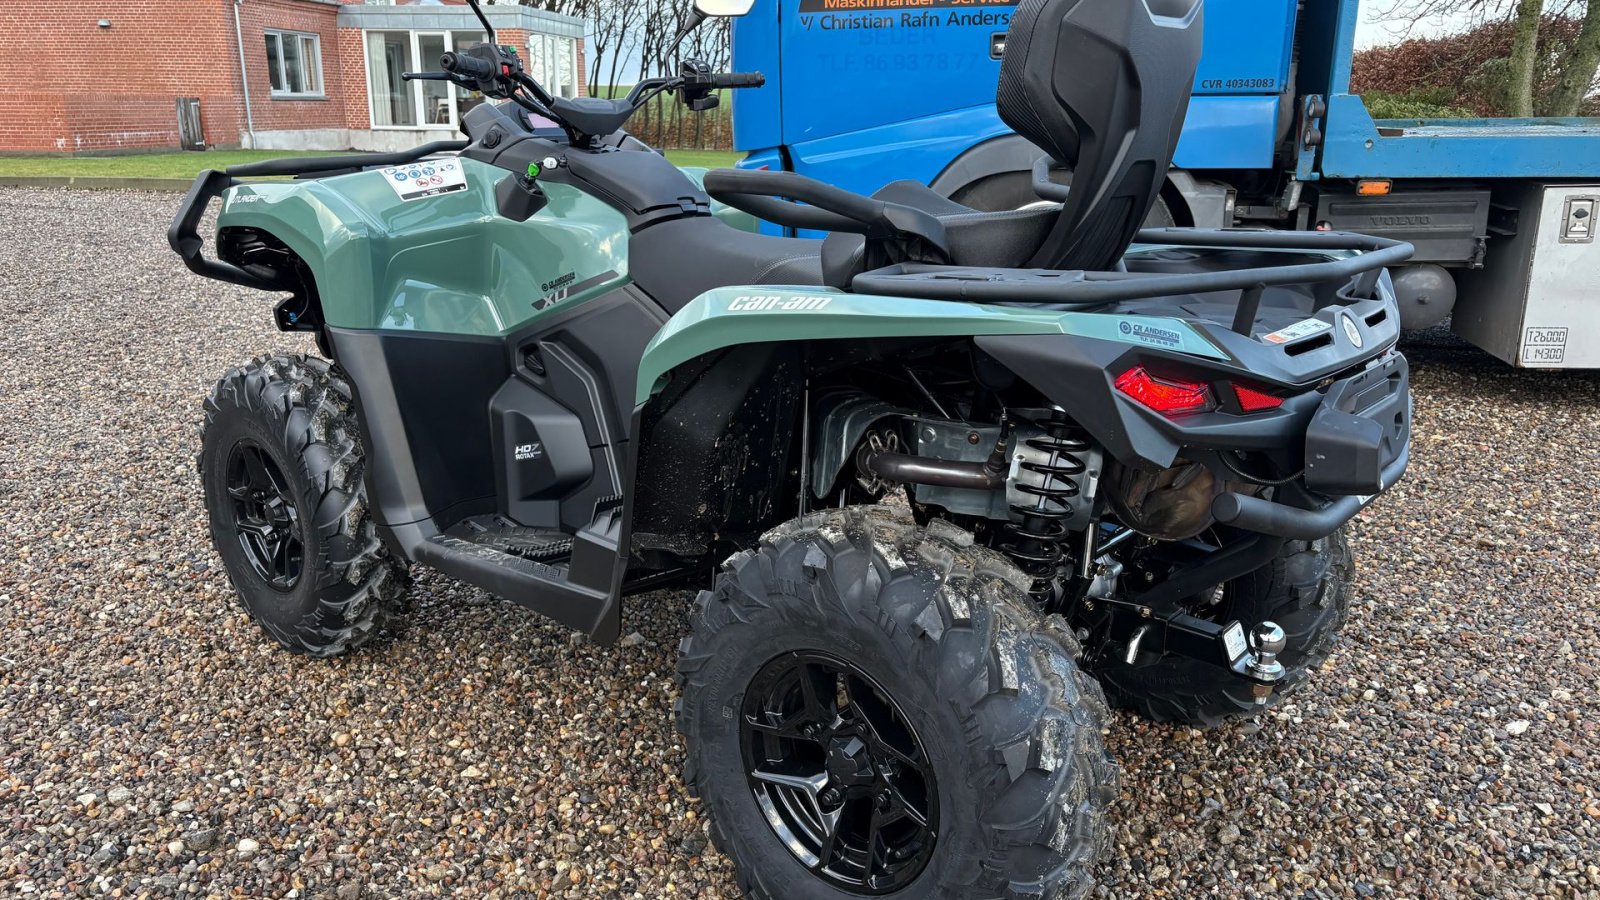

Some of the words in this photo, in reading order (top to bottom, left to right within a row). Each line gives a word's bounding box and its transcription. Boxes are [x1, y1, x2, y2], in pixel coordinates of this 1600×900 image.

[820, 14, 894, 30] Christian
[900, 11, 940, 27] Rafn
[946, 10, 1010, 26] Anders
[864, 53, 889, 71] 86
[893, 53, 919, 71] 93
[923, 53, 949, 71] 78
[954, 52, 979, 71] 77
[1201, 79, 1222, 89] CVR
[1226, 78, 1275, 88] 40343083
[1370, 214, 1432, 226] VOLVO
[727, 295, 833, 311] can-am
[1133, 324, 1143, 332] CR
[1144, 326, 1180, 340] ANDERSEN
[515, 443, 540, 454] HD7
[515, 452, 535, 460] ROTAX
